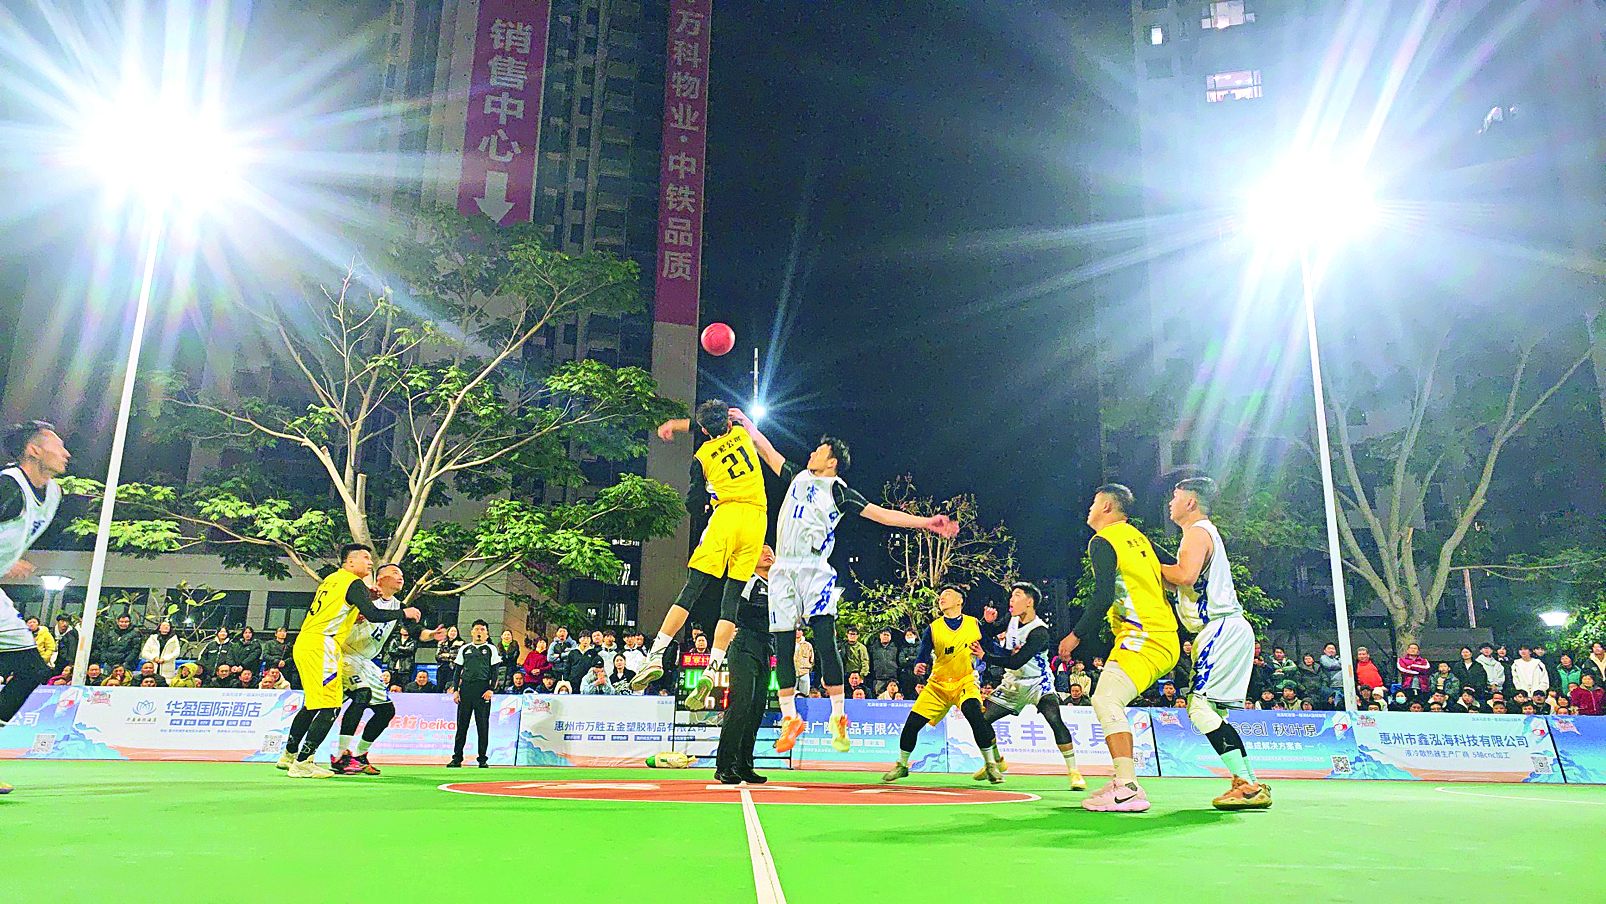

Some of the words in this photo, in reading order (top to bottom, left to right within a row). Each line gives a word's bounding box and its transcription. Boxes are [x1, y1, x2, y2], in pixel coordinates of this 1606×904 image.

[478, 18, 532, 163] 销售中心
[662, 0, 704, 281] 万科物业·中铁品质
[721, 446, 754, 480] 21
[793, 504, 805, 519] 11
[348, 674, 362, 685] 12
[165, 700, 262, 718] 华盈国际酒店
[553, 720, 707, 733] 惠州市万胜五金塑胶制品有限公司
[1272, 722, 1317, 737] 秋叶原
[1378, 732, 1529, 748] 惠州市鑫泓海科技有限公司
